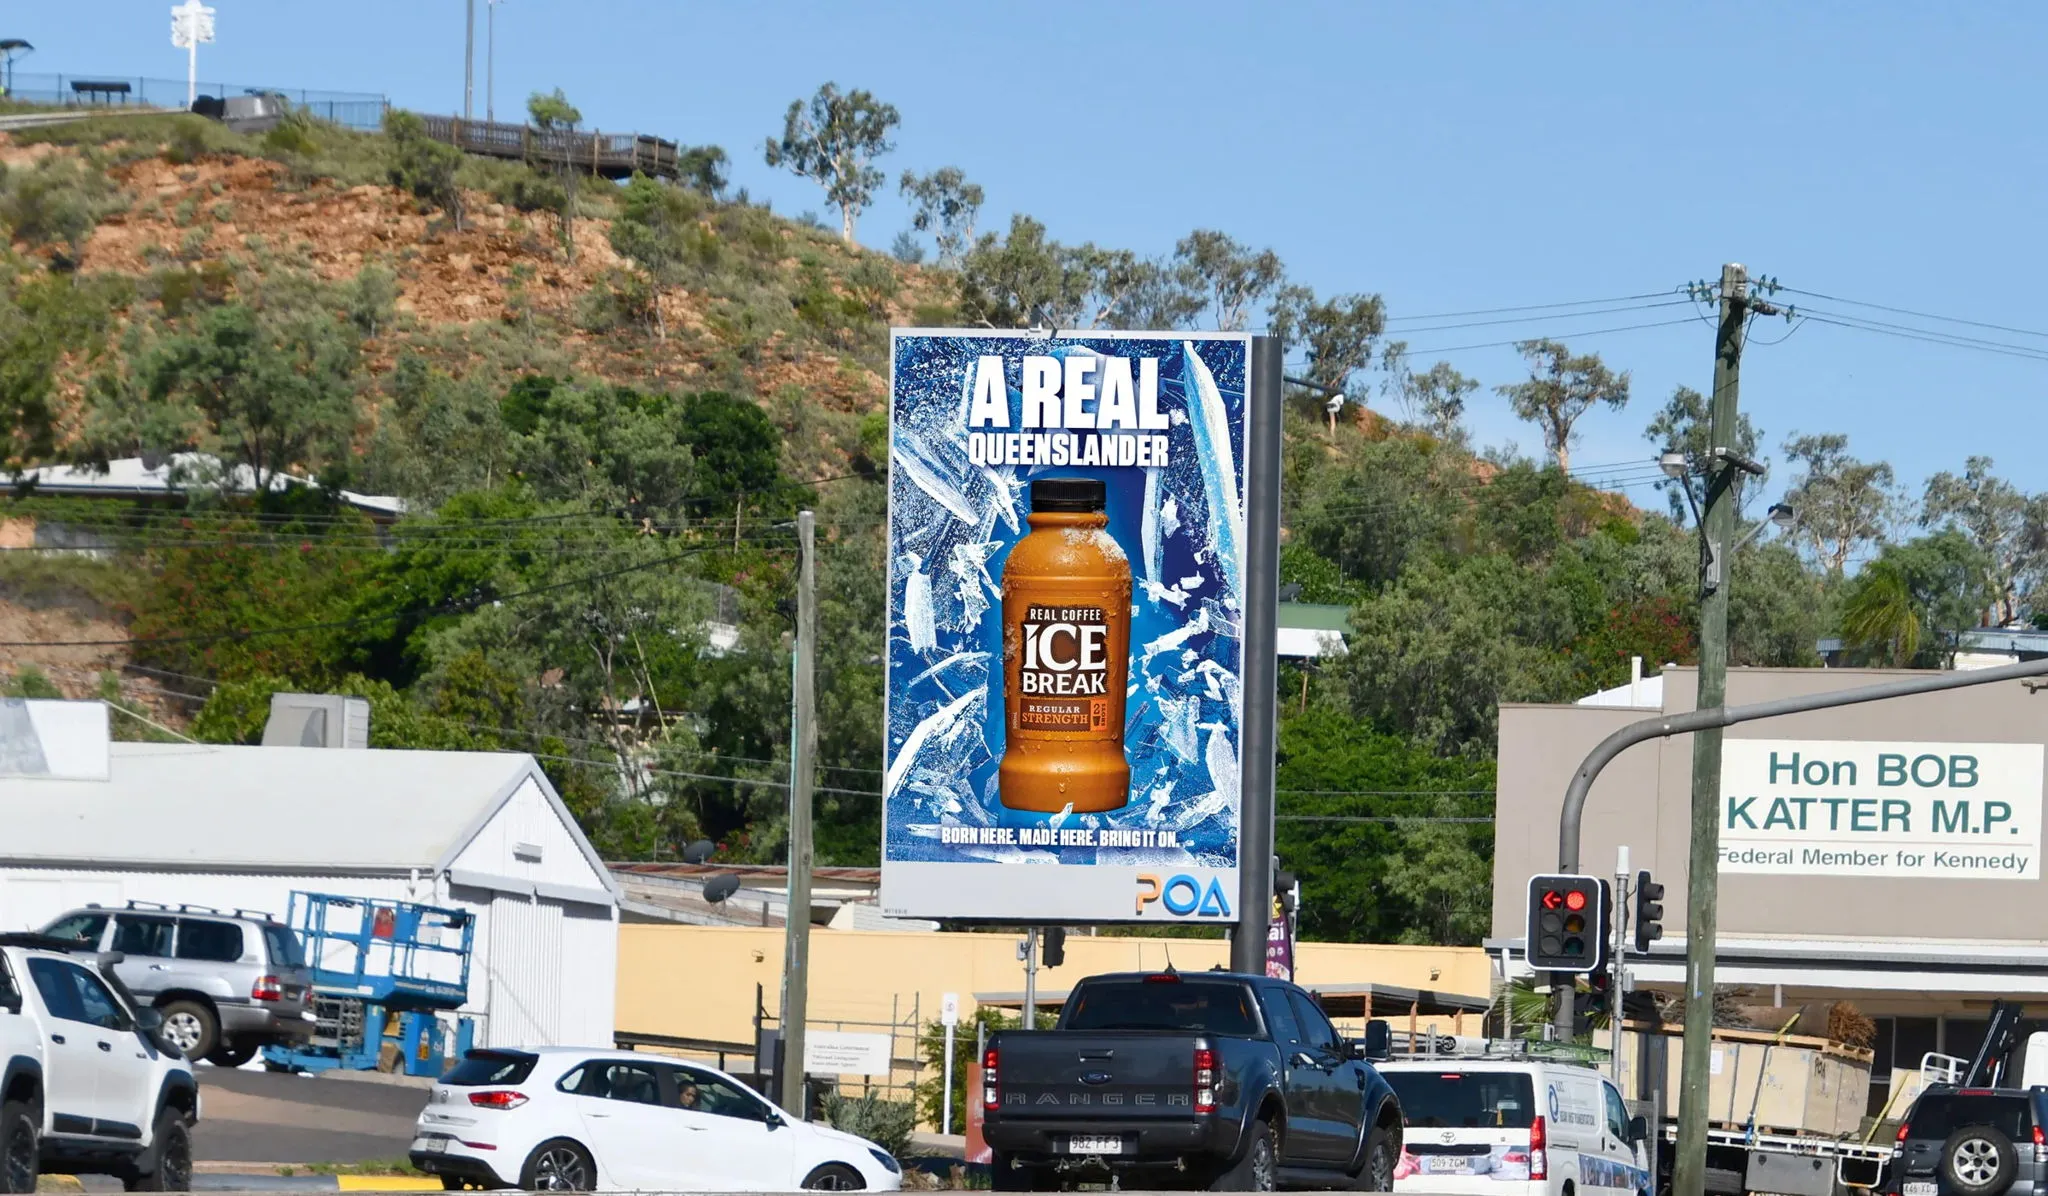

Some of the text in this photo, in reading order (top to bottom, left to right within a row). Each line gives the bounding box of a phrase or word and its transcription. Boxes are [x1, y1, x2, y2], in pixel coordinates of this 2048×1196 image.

[969, 355, 1170, 430] A REAL
[968, 432, 1169, 467] QUEENSLANDER
[1030, 608, 1101, 621] REAL COFFEE
[1023, 623, 1107, 671] ICE
[1022, 672, 1107, 694] BREAK
[1022, 713, 1088, 724] STRENGTH
[1029, 703, 1101, 715] REGULAR 2
[1769, 752, 1979, 788] Hon BOB
[1727, 796, 2018, 834] KATTER M.P.
[941, 827, 1180, 847] BORN HERE. MADE HERE. BRING IT ON.
[1717, 846, 2028, 873] Federal Member for Kennedy
[1136, 873, 1231, 917] POA
[1005, 1093, 1189, 1106] RANGER
[1072, 1136, 1091, 1149] 982
[1431, 1158, 1446, 1168] 509
